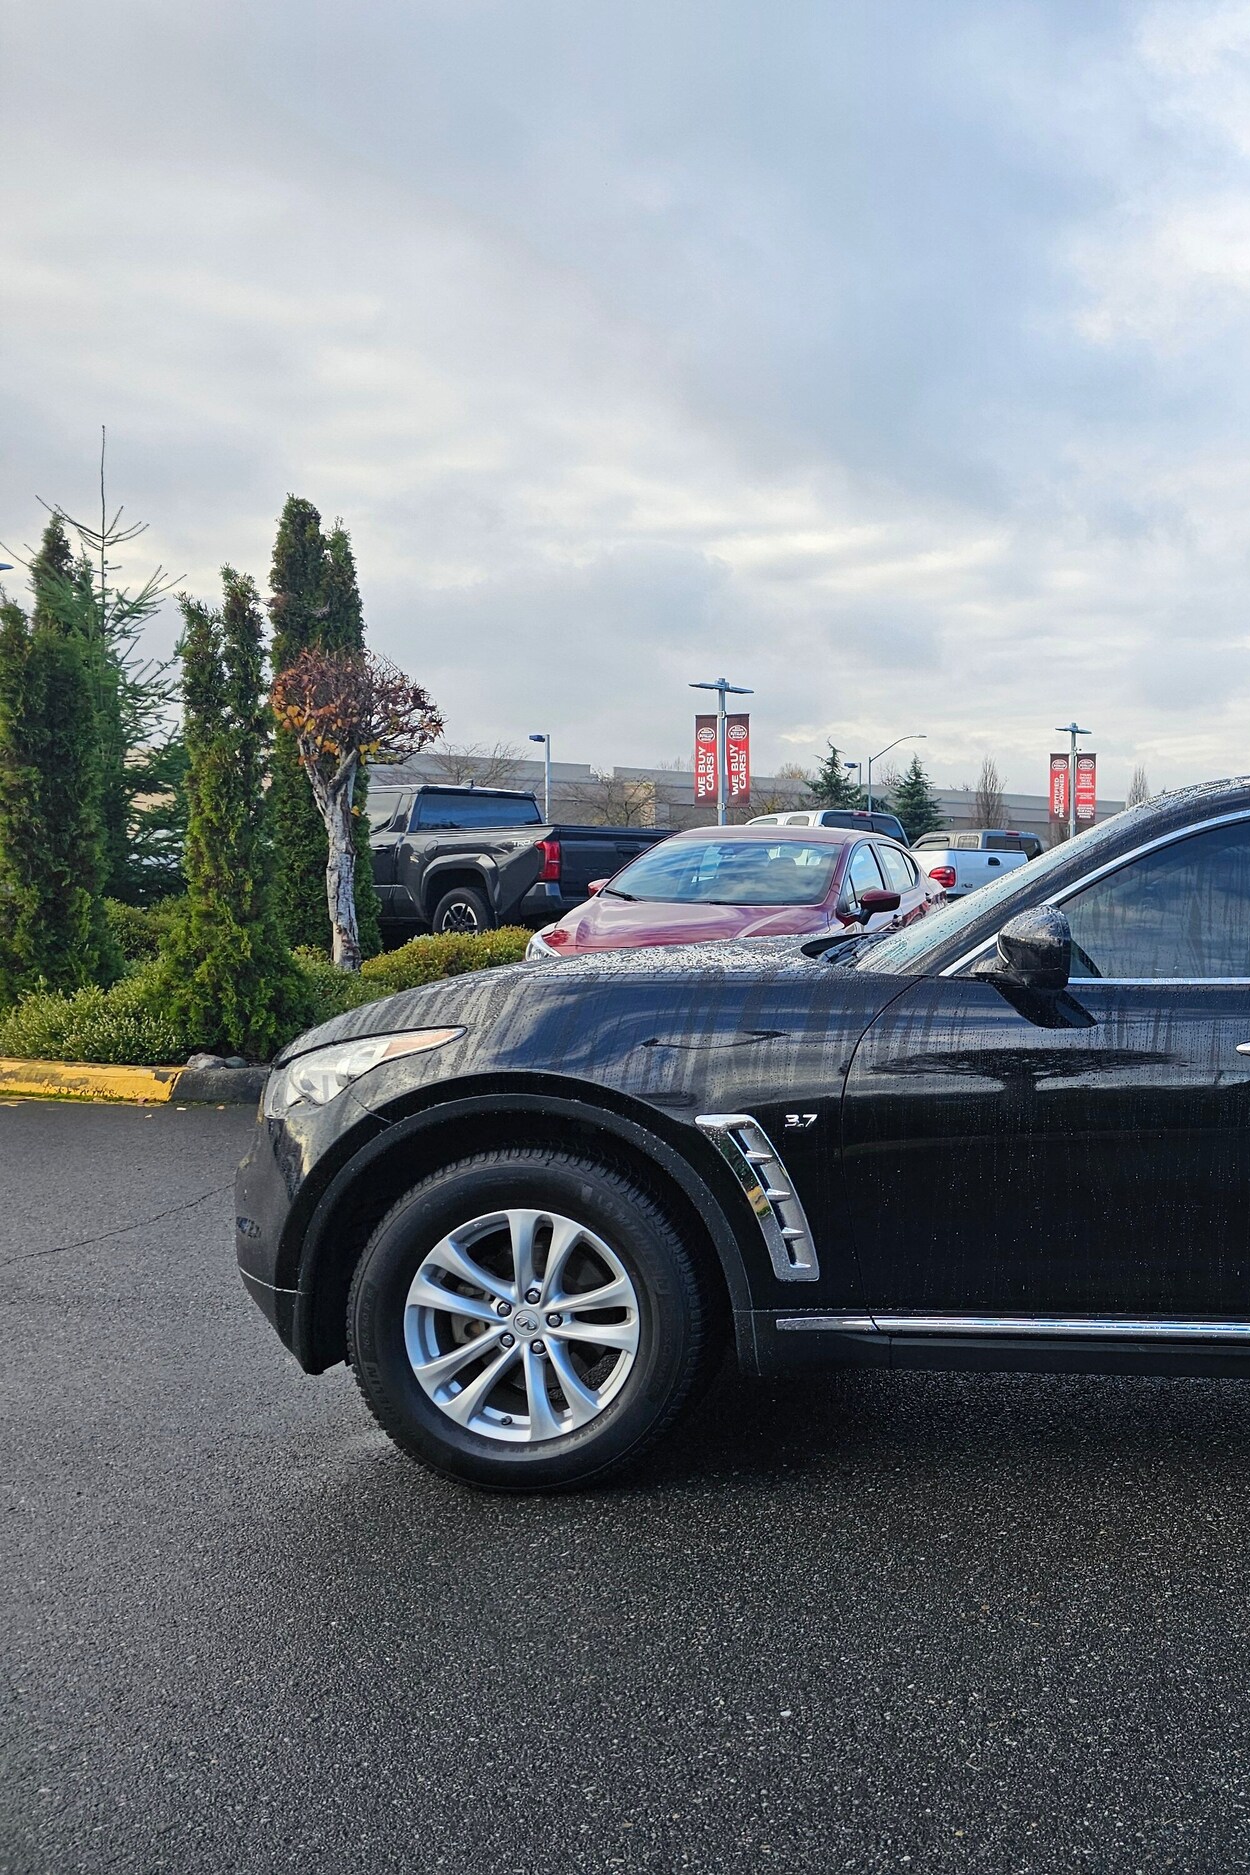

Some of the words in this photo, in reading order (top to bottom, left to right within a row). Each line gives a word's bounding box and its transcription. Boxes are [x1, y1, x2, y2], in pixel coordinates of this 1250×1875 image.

[698, 746, 706, 774] BUY
[729, 744, 739, 771] BUY
[739, 750, 747, 789] CARS!
[706, 752, 714, 791] CARS!
[698, 776, 706, 797] WE
[731, 774, 739, 796] WE
[512, 840, 531, 848] TRD
[784, 1114, 818, 1128] 3.7
